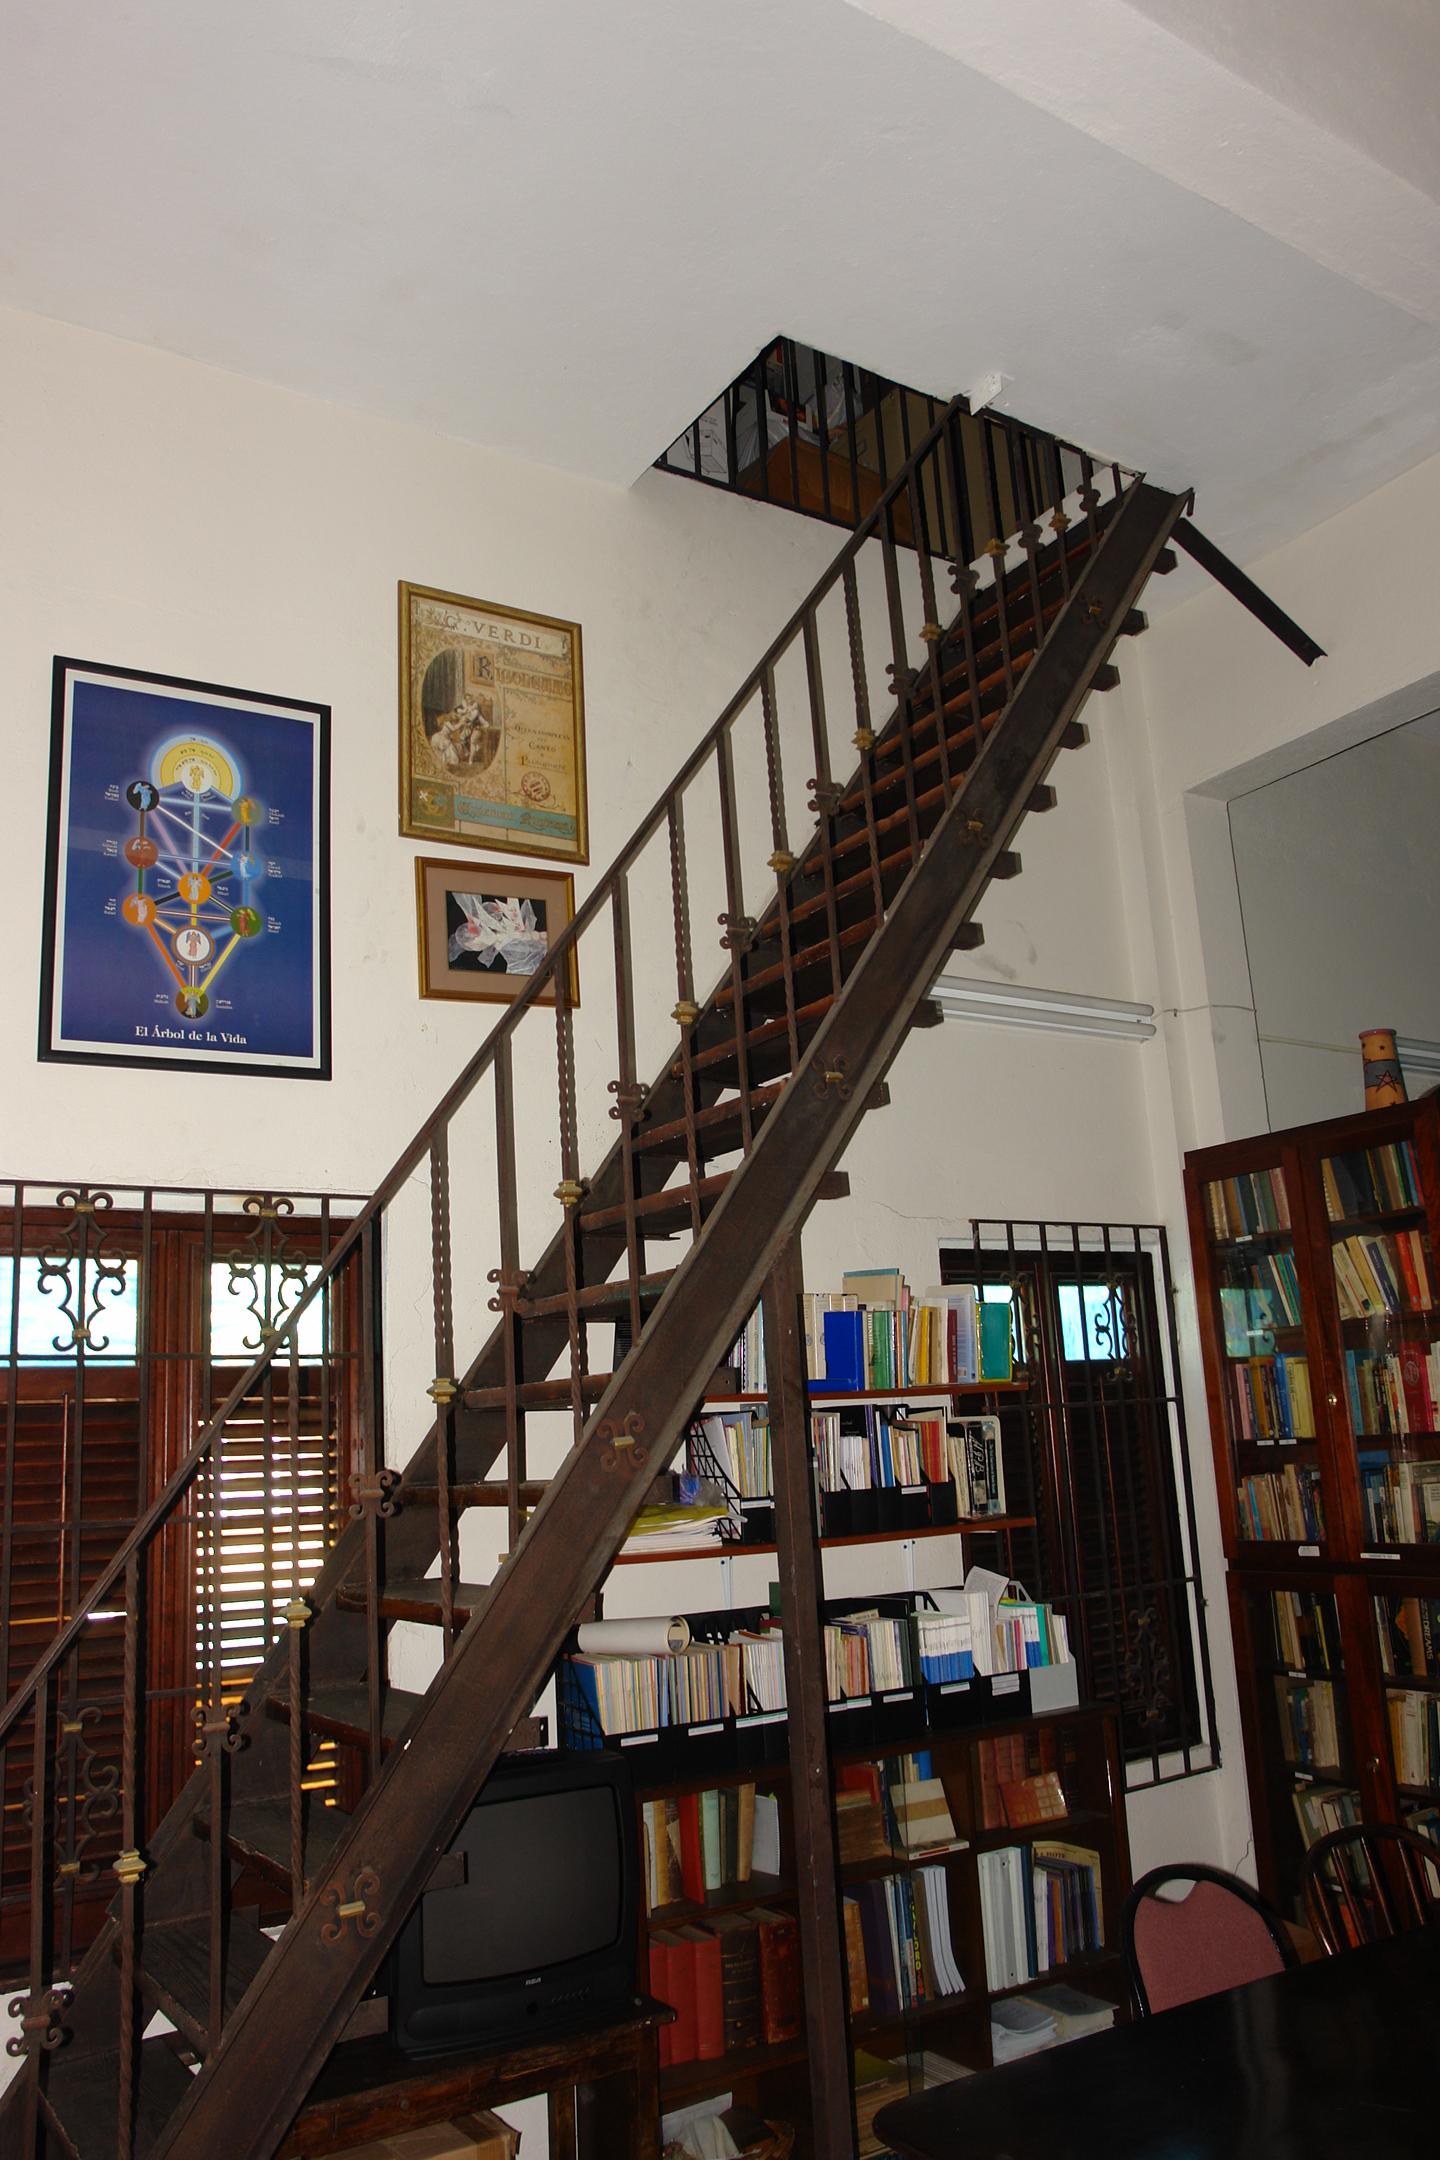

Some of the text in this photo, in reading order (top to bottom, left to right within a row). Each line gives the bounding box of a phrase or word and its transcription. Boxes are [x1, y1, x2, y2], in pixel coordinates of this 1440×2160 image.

[473, 620, 542, 649] VERDI
[135, 1024, 248, 1045] El Árbol de la Vida
